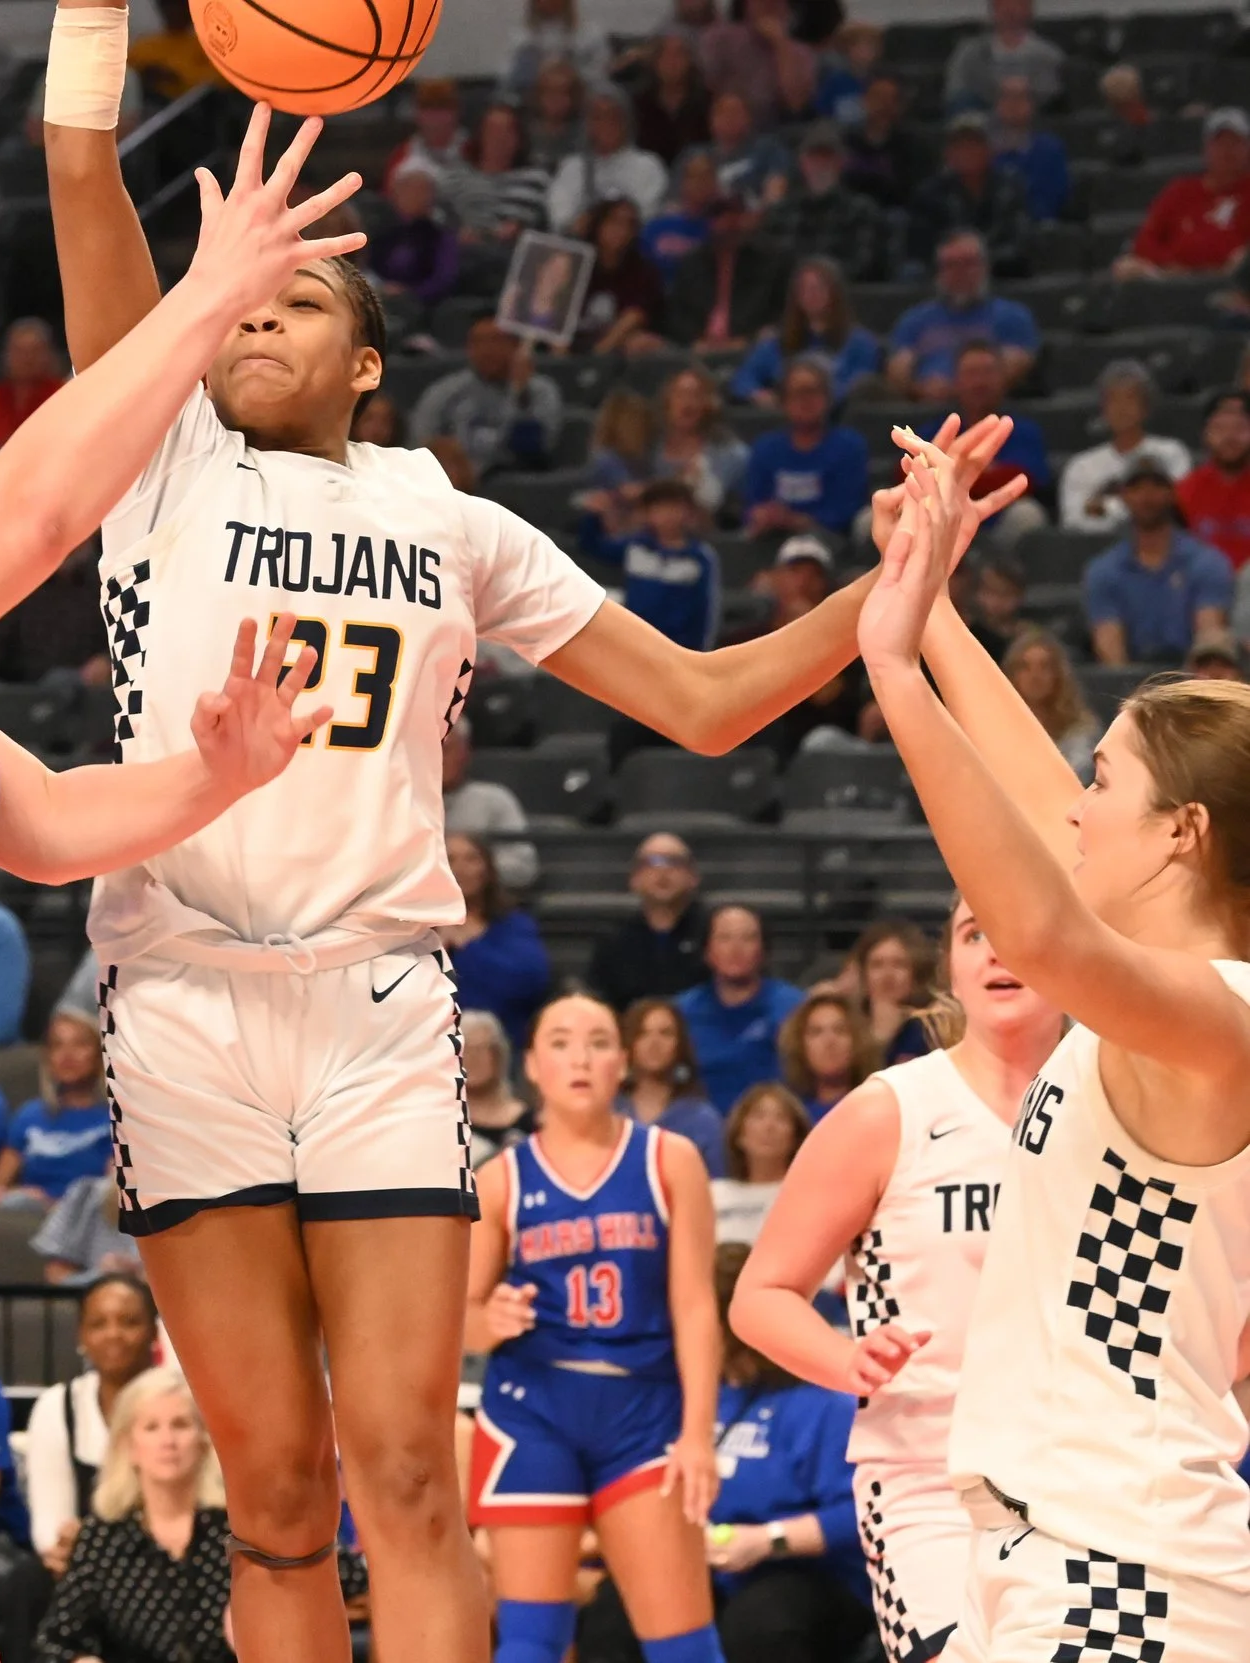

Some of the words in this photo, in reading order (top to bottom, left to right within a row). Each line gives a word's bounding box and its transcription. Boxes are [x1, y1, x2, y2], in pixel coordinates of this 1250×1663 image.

[224, 520, 442, 610] TROJANS
[596, 1210, 659, 1251] HILL
[934, 1182, 1002, 1233] TR
[565, 1261, 624, 1329] 13
